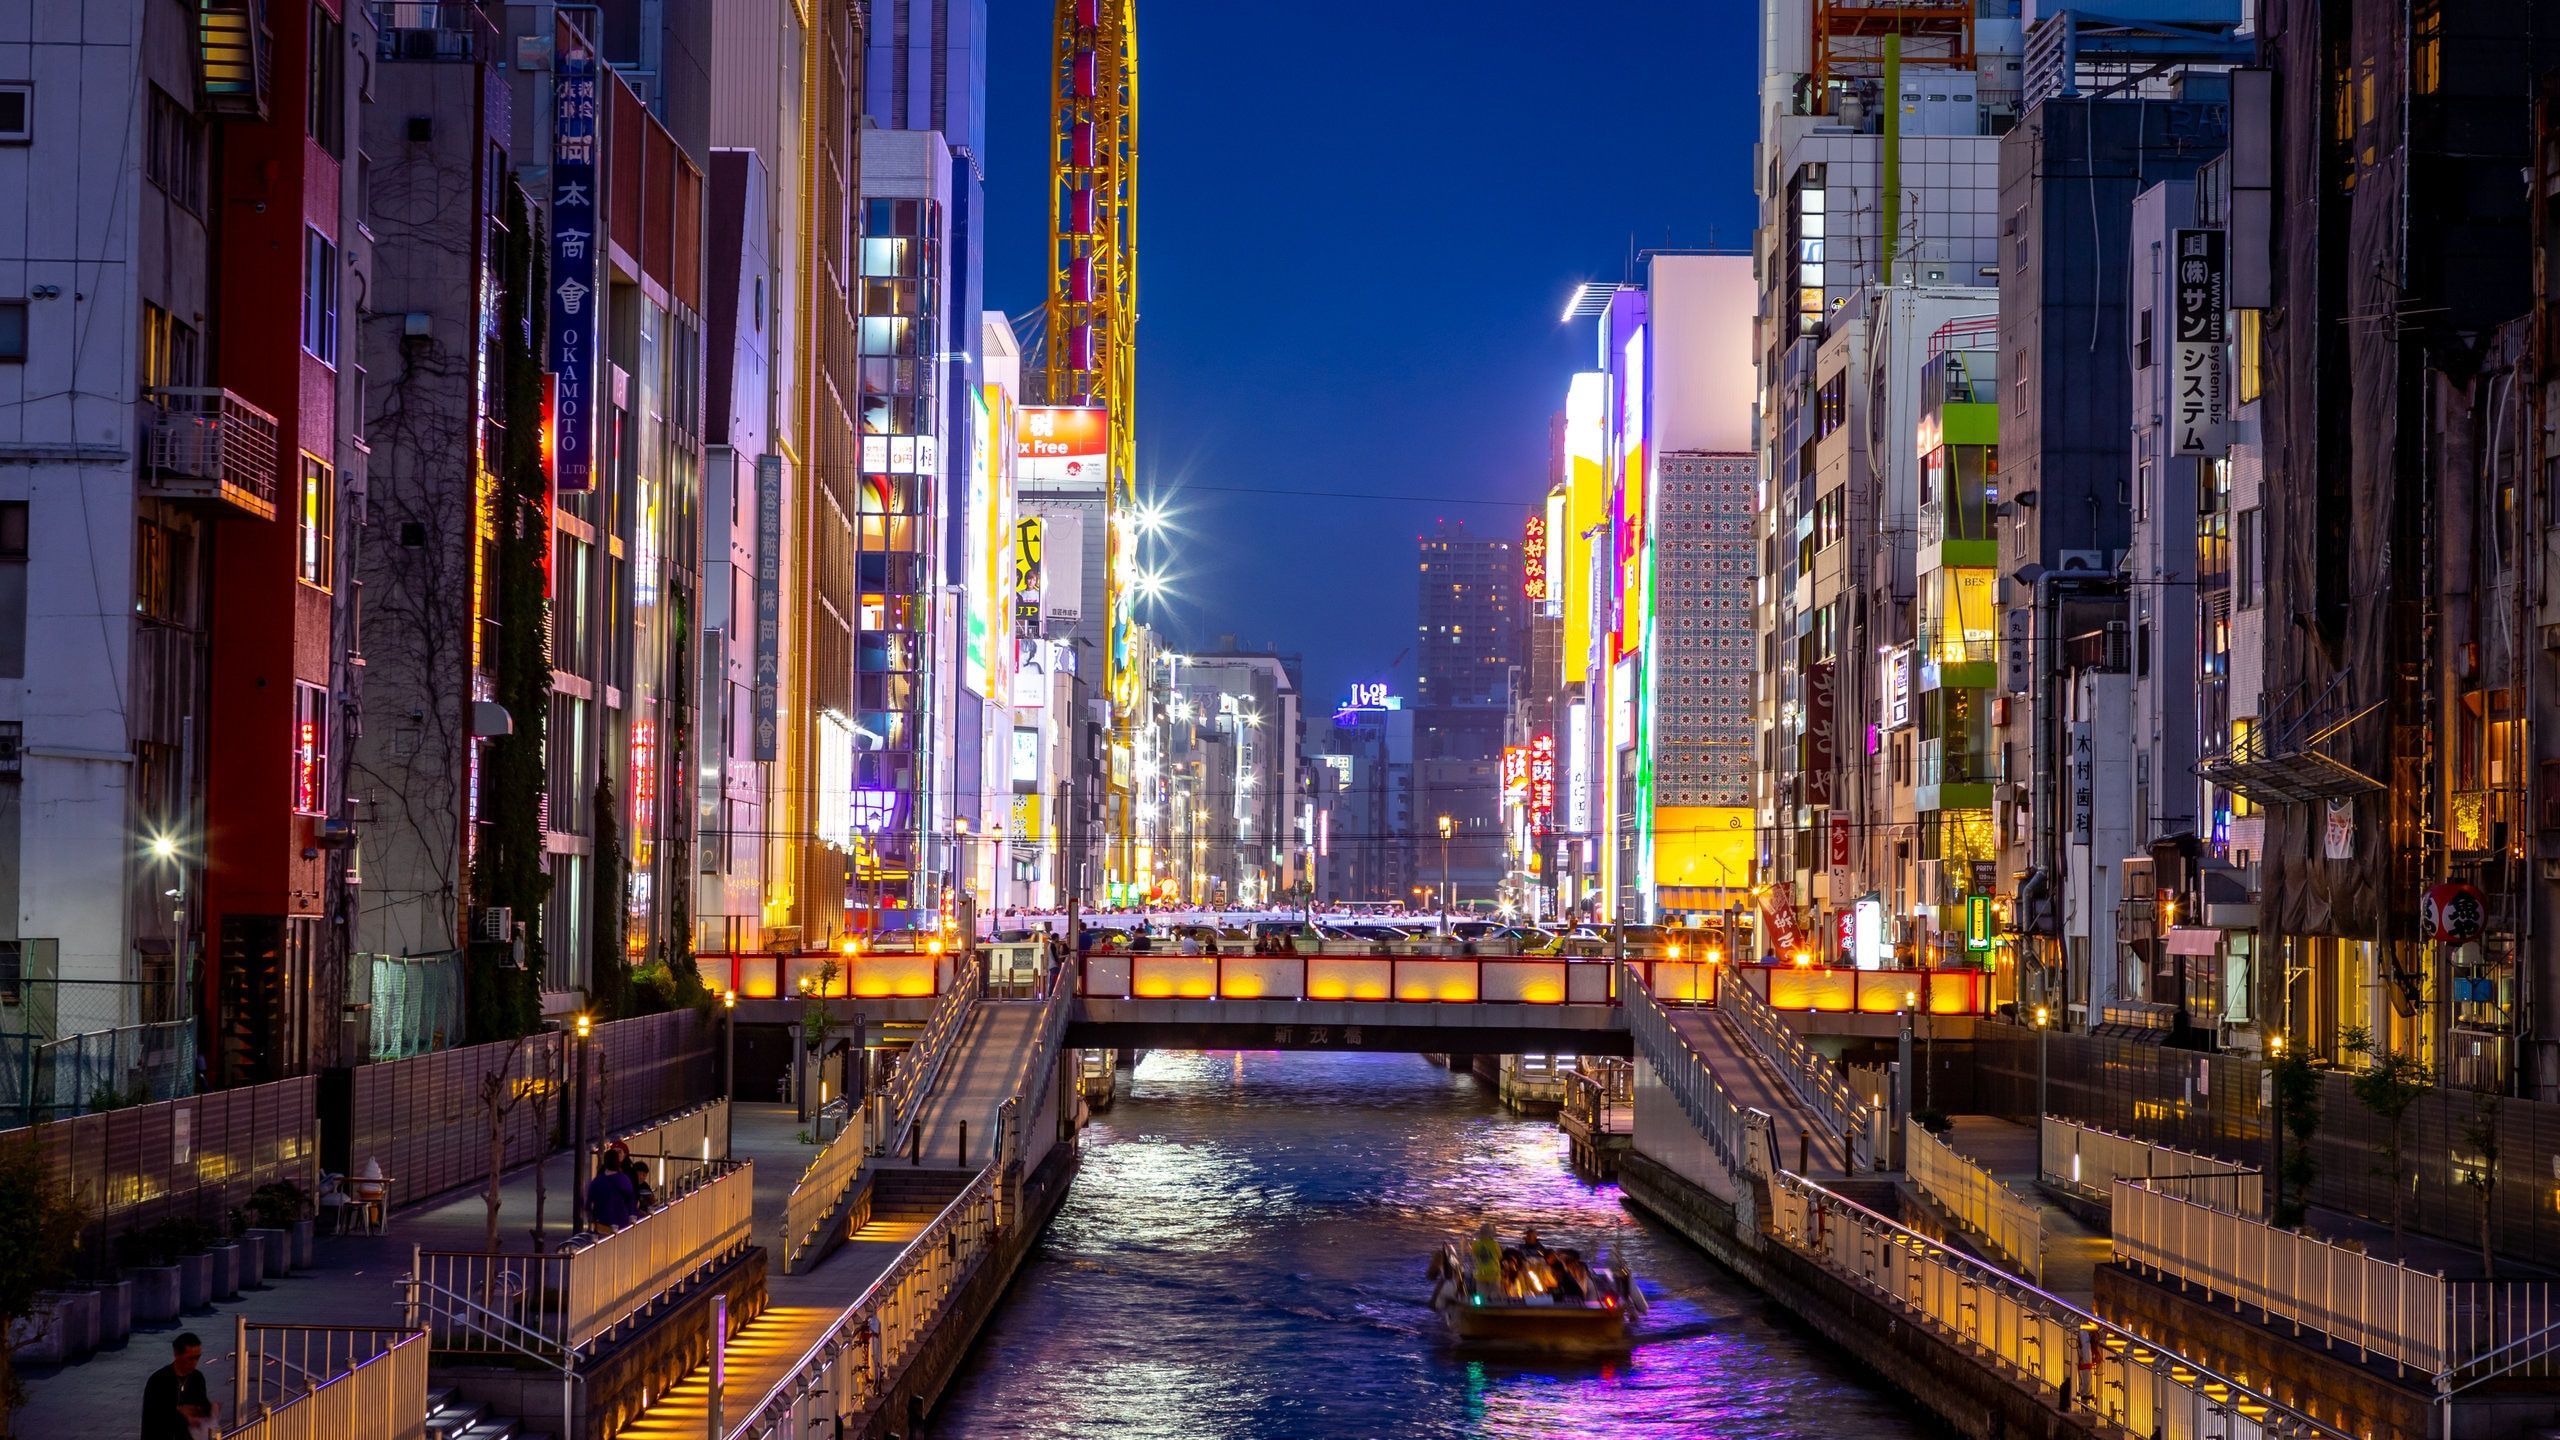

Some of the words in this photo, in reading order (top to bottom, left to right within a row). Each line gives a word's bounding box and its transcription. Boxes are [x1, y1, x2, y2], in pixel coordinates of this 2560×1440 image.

[561, 329, 578, 451] OKAMOTO
[1034, 440, 1069, 454] Free
[1523, 516, 1546, 598] お好み焼
[2076, 734, 2091, 833] 木村歯科
